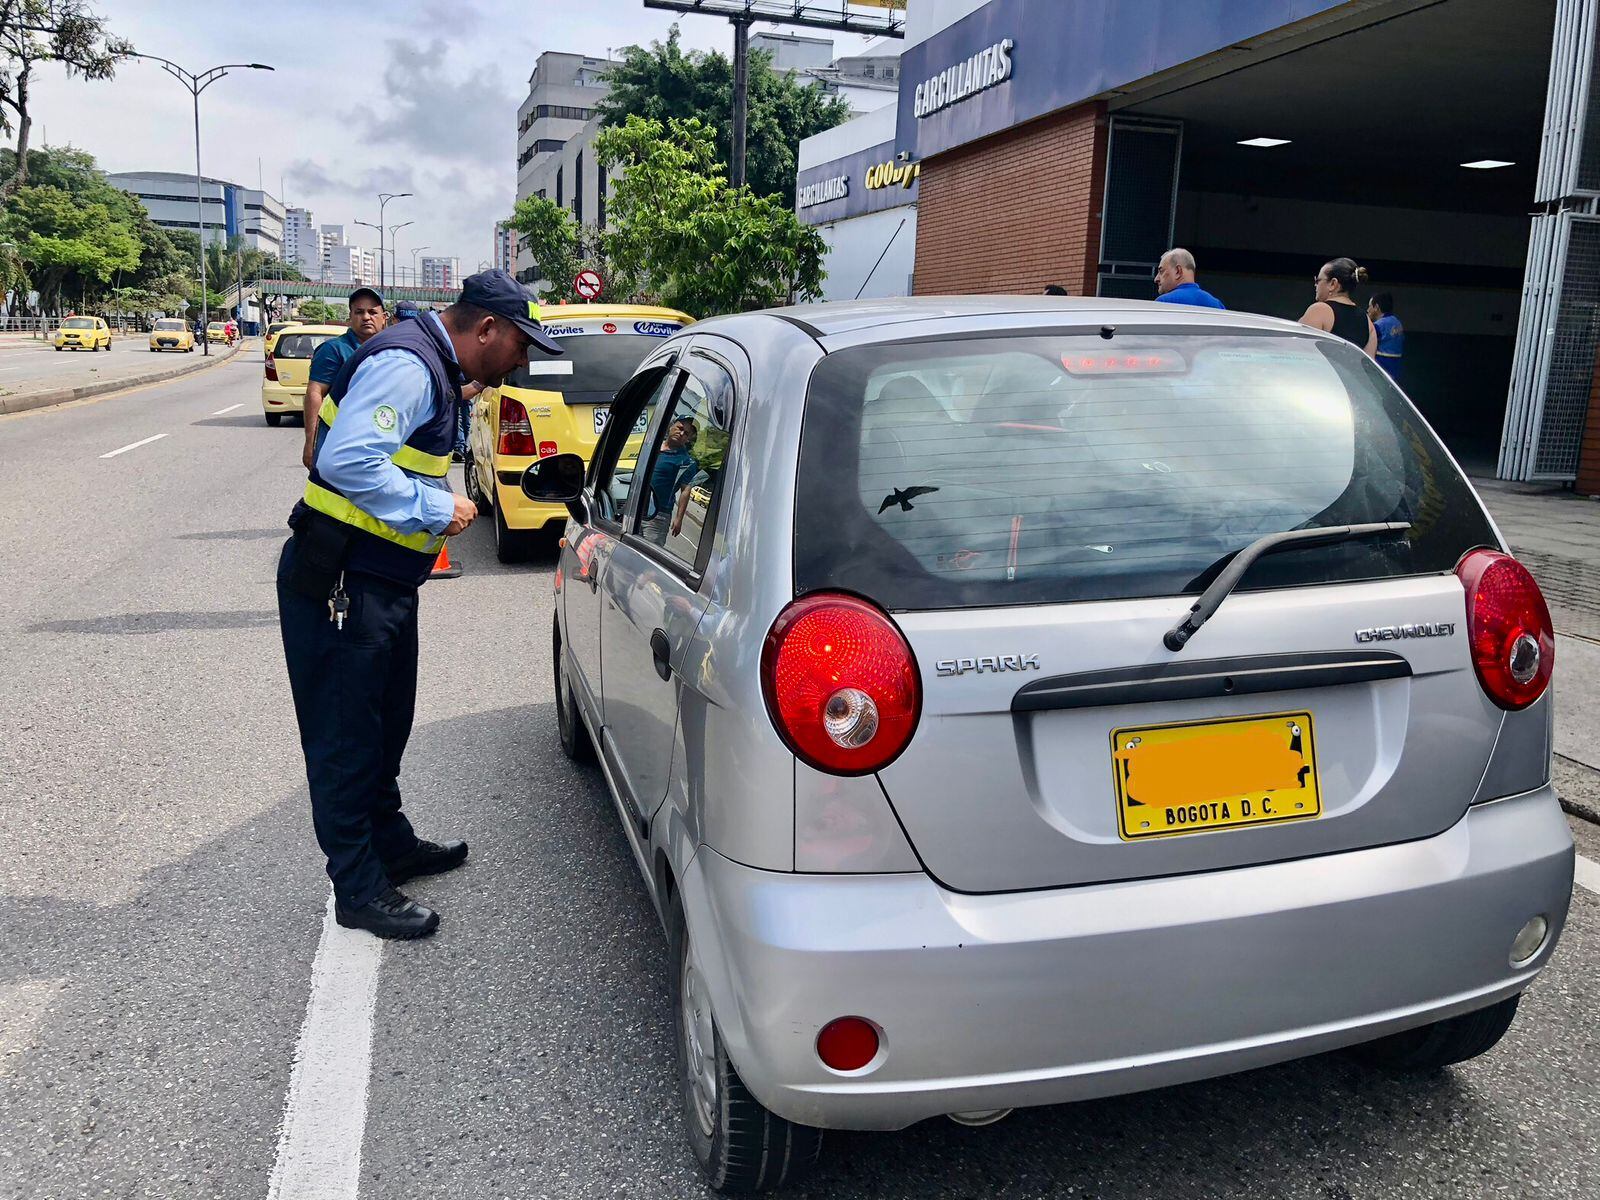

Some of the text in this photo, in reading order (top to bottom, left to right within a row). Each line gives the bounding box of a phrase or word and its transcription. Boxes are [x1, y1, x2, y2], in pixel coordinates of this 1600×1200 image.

[914, 38, 1013, 118] GARCILLANTAS
[799, 175, 848, 208] GARCILLANTAS
[603, 324, 617, 333] App
[1354, 623, 1456, 643] CHEVROLET
[936, 653, 1040, 677] SPARK
[1165, 802, 1231, 826] BOGOTA
